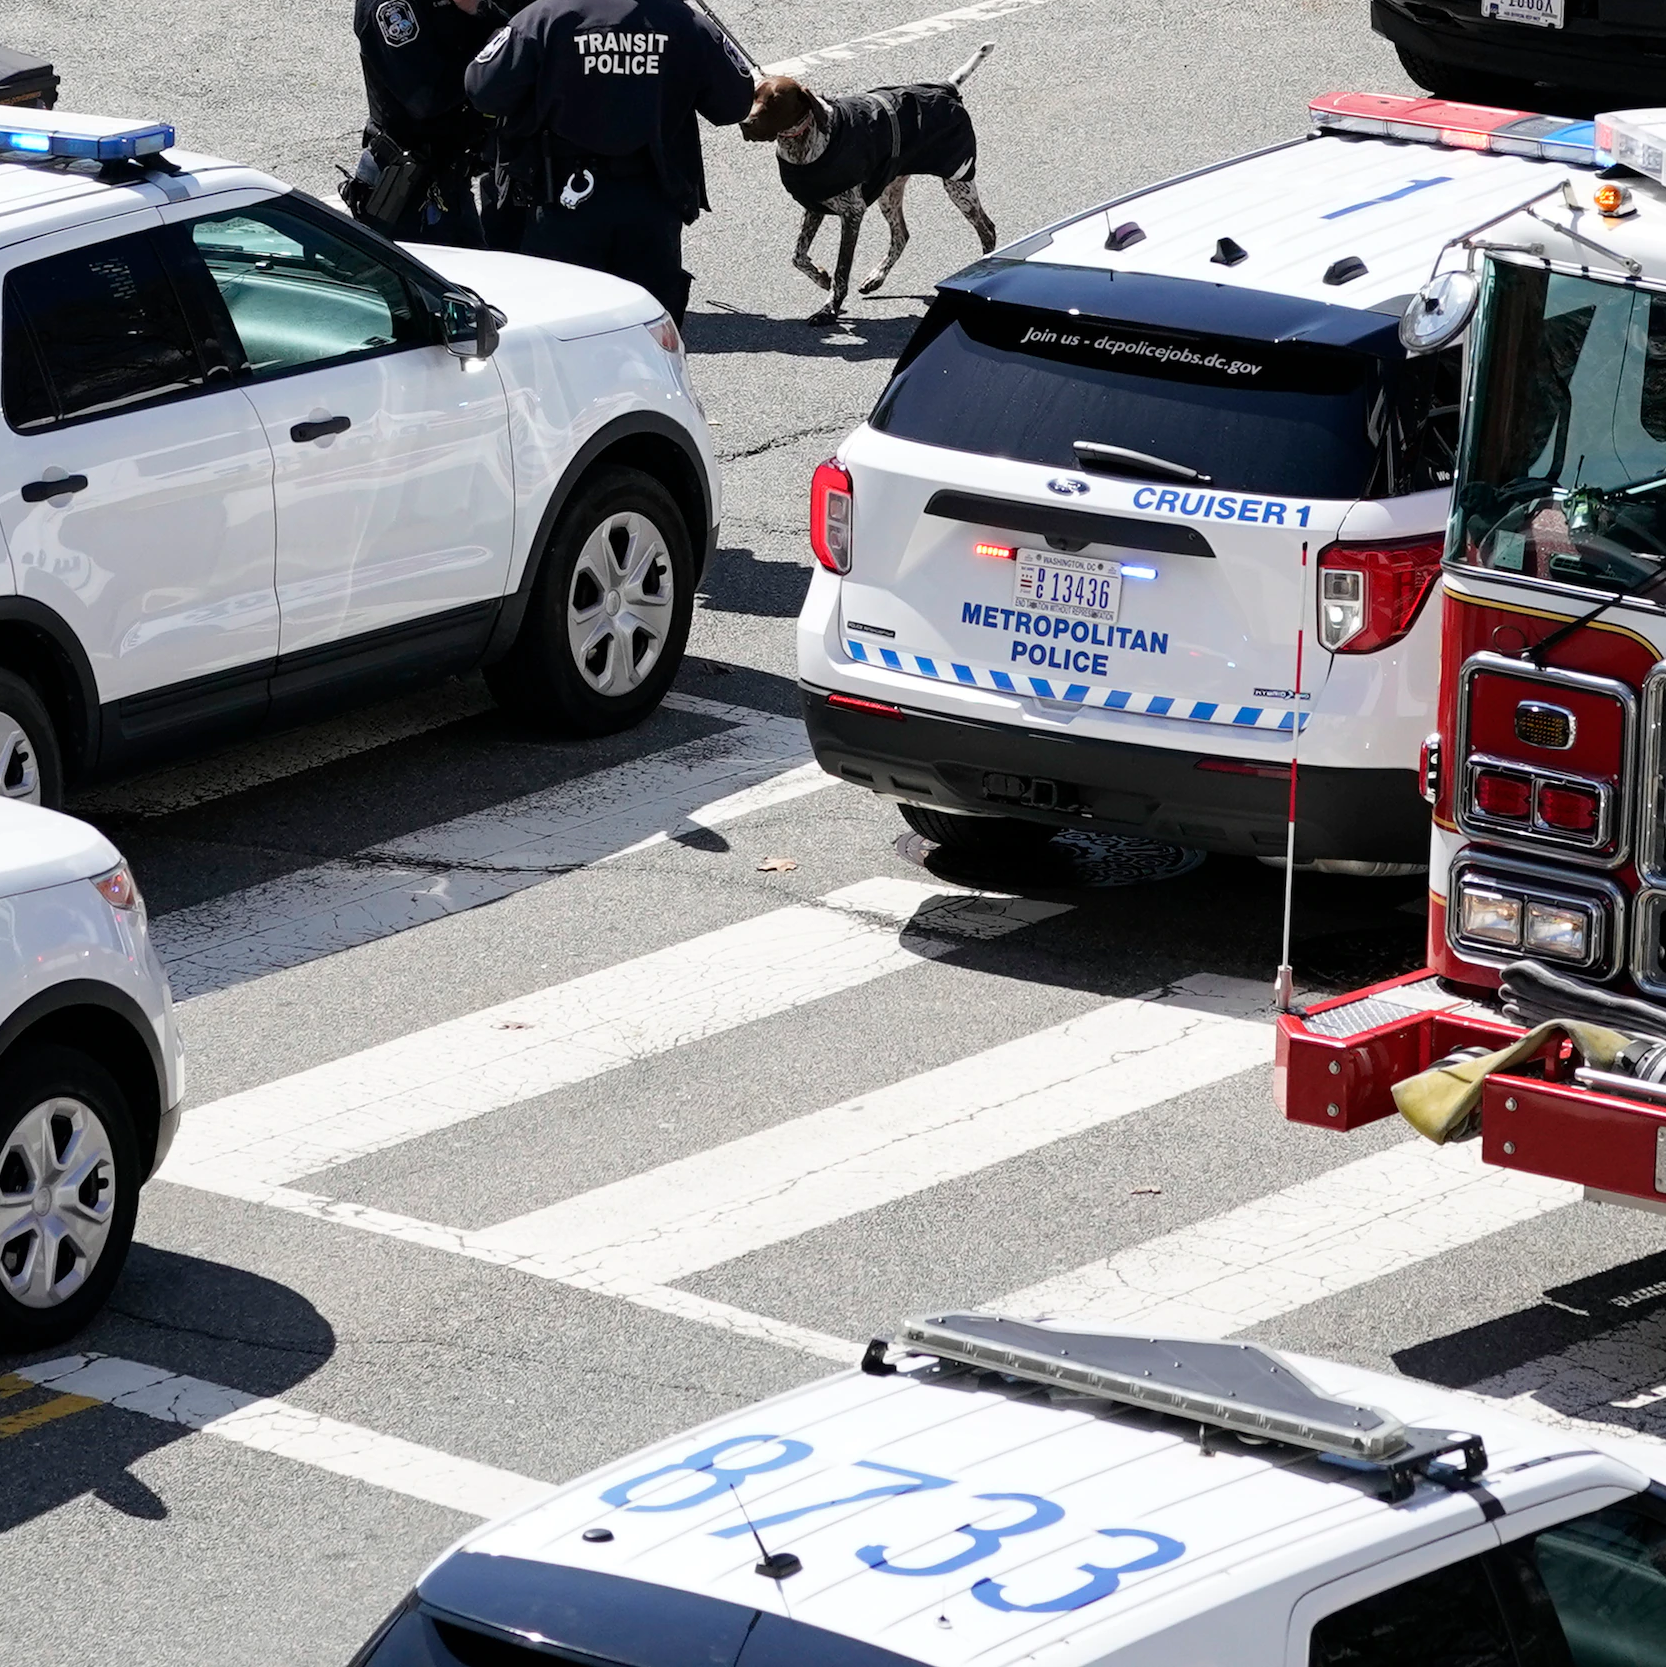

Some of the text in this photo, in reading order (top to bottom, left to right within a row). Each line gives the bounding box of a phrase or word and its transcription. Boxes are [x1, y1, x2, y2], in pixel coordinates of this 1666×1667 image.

[574, 32, 669, 55] TRANSIT
[584, 55, 660, 75] POLICE
[1021, 327, 1057, 344] Join
[1061, 332, 1081, 345] us
[1094, 336, 1262, 375] dcpolicejobs.dc.gov
[1436, 470, 1450, 482] We
[1133, 487, 1311, 527] CRUISER 1
[1050, 572, 1110, 609] 13436
[962, 602, 1169, 654] METROPOLITAN
[1011, 640, 1109, 676] POLICE
[598, 1434, 1186, 1613] 8733
